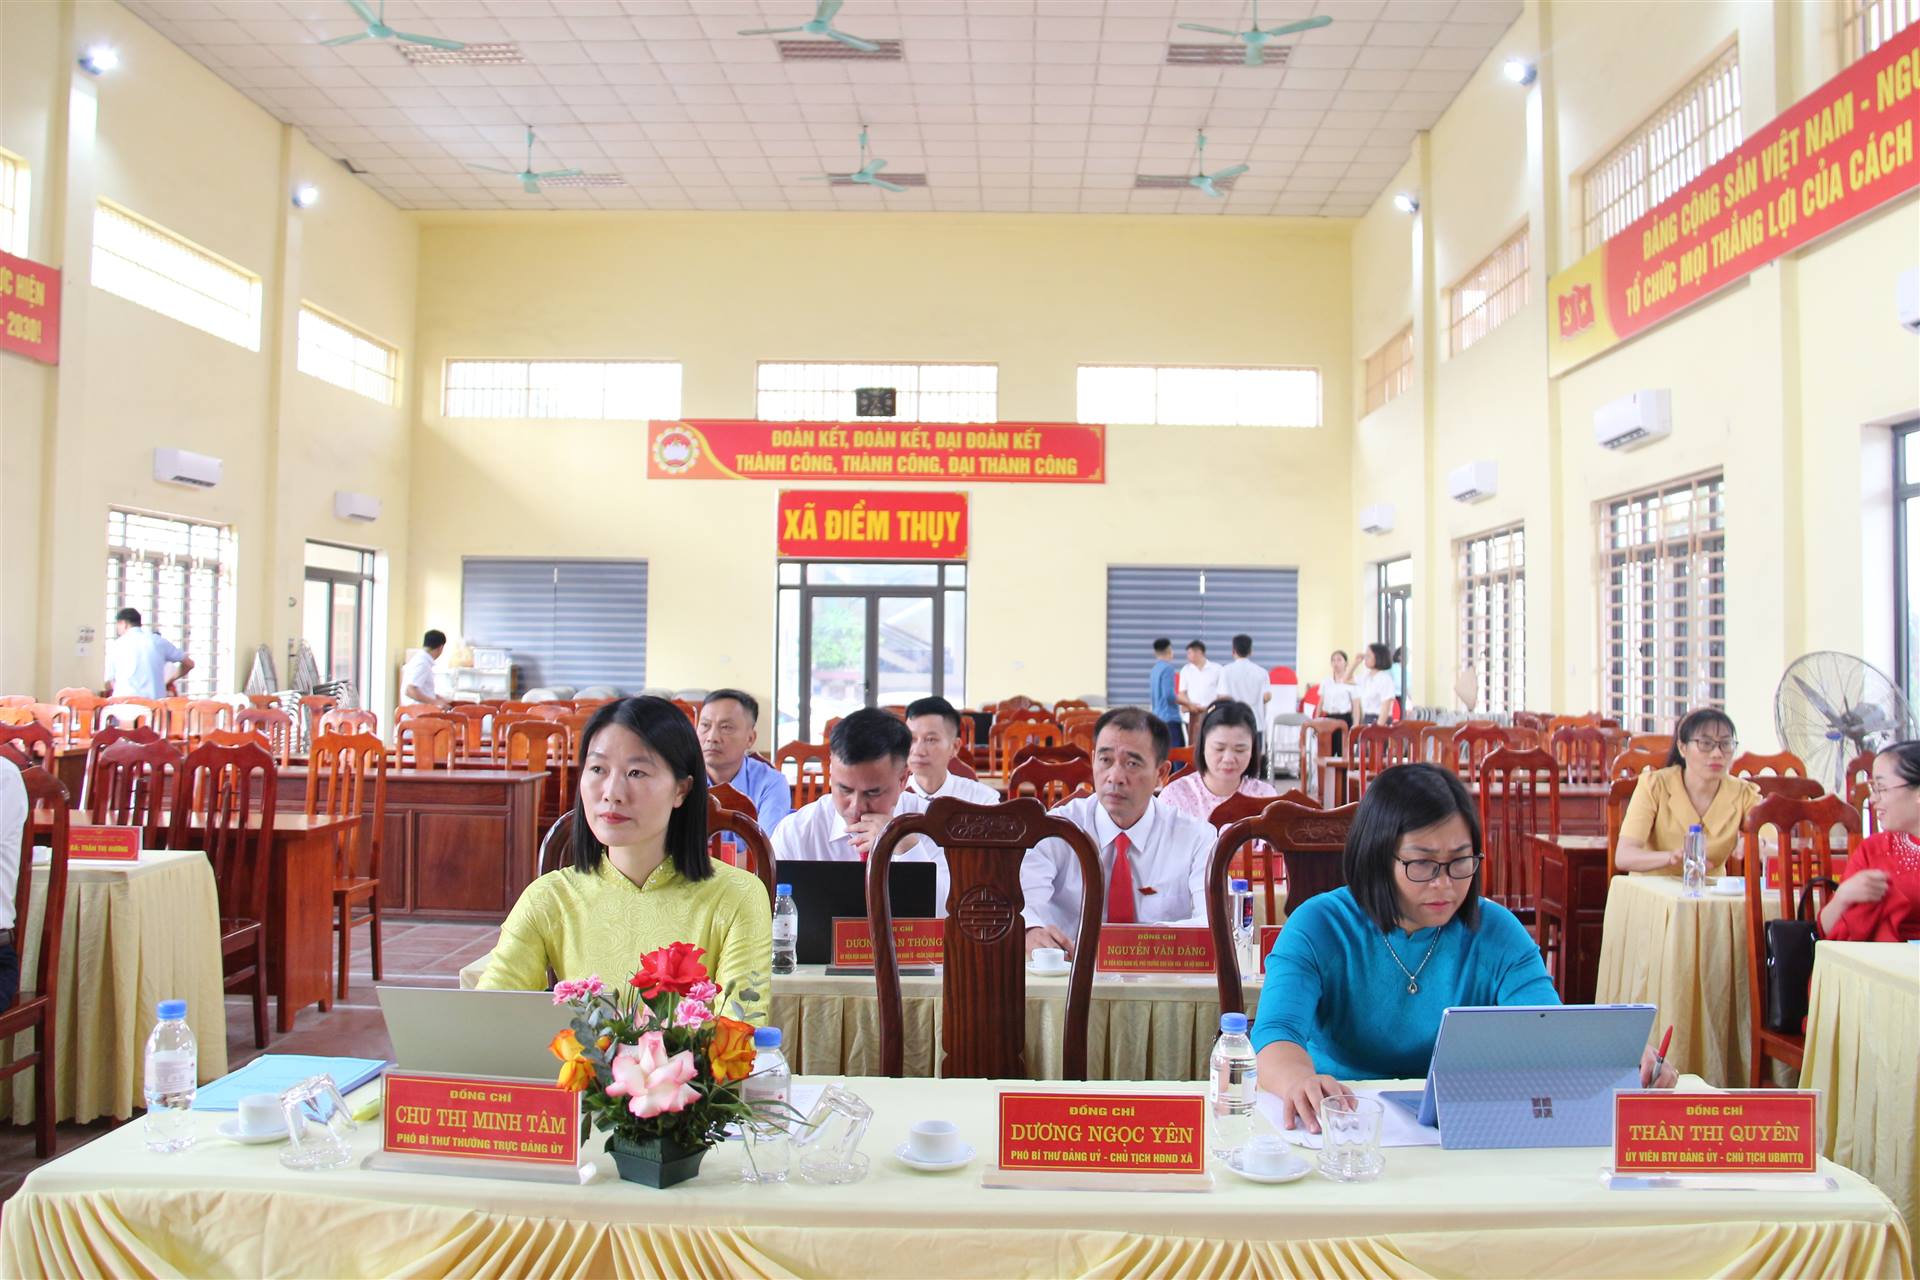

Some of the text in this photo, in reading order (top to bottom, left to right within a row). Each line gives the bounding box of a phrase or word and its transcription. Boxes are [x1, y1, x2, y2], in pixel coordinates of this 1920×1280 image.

[1643, 213, 1678, 261] ĐẢNG
[1681, 183, 1720, 237] CỘNG
[1724, 153, 1758, 208] SẢN
[1762, 128, 1800, 183] VIỆT
[1805, 91, 1854, 157] NAM
[1643, 260, 1677, 307] CHỨC
[1680, 241, 1708, 286] MỌI
[1711, 209, 1764, 269] THẮNG
[1768, 187, 1797, 239] LỢI
[1802, 158, 1844, 217] CỦA
[1850, 119, 1913, 191] CÁCH
[16, 274, 45, 308] HIỆN
[771, 425, 1042, 452] ĐOÀN KẾT, ĐOÀN KẾT, ĐẠI ĐOÀN KẾT
[735, 451, 1077, 477] THÀNH CÔNG, THÀNH CÔNG, ĐẠI THÀNH CÔNG
[783, 499, 961, 548] XÃ ĐIỀM THỤY
[846, 938, 872, 948] DƯƠN
[450, 1088, 512, 1103] ĐỒNG CHÍ
[396, 1105, 567, 1135] CHU THỊ MINH TÂM
[1069, 1104, 1135, 1117] ĐỒNG CHÍ
[1686, 1104, 1743, 1116] ĐỒNG CHÍ
[397, 1132, 416, 1144] PHÓ
[419, 1133, 428, 1145] BÍ
[432, 1135, 450, 1146] THƯ
[453, 1136, 490, 1149] THƯỜNG
[494, 1140, 518, 1152] TRỰC
[521, 1140, 548, 1153] ĐẢNG
[1011, 1122, 1194, 1147] DƯƠNG NGỌC YÊN
[1629, 1120, 1800, 1146] THÂN THỊ QUYÊN
[1011, 1149, 1029, 1160] PHÓ
[1031, 1149, 1040, 1161] BÍ
[1043, 1150, 1061, 1161] THƯ
[1062, 1148, 1087, 1162] ĐẢNG
[1110, 1149, 1128, 1163] CHỦ
[1130, 1152, 1151, 1165] TỊCH
[1154, 1153, 1178, 1163] HĐND
[1181, 1152, 1193, 1164] XÃ
[1639, 1149, 1659, 1162] VIÊN
[1661, 1151, 1678, 1162] BTV
[1680, 1147, 1705, 1163] ĐẢNG
[1726, 1148, 1744, 1163] CHỦ
[1746, 1152, 1766, 1165] TỊCH
[1768, 1152, 1804, 1164] UBMTTQ
